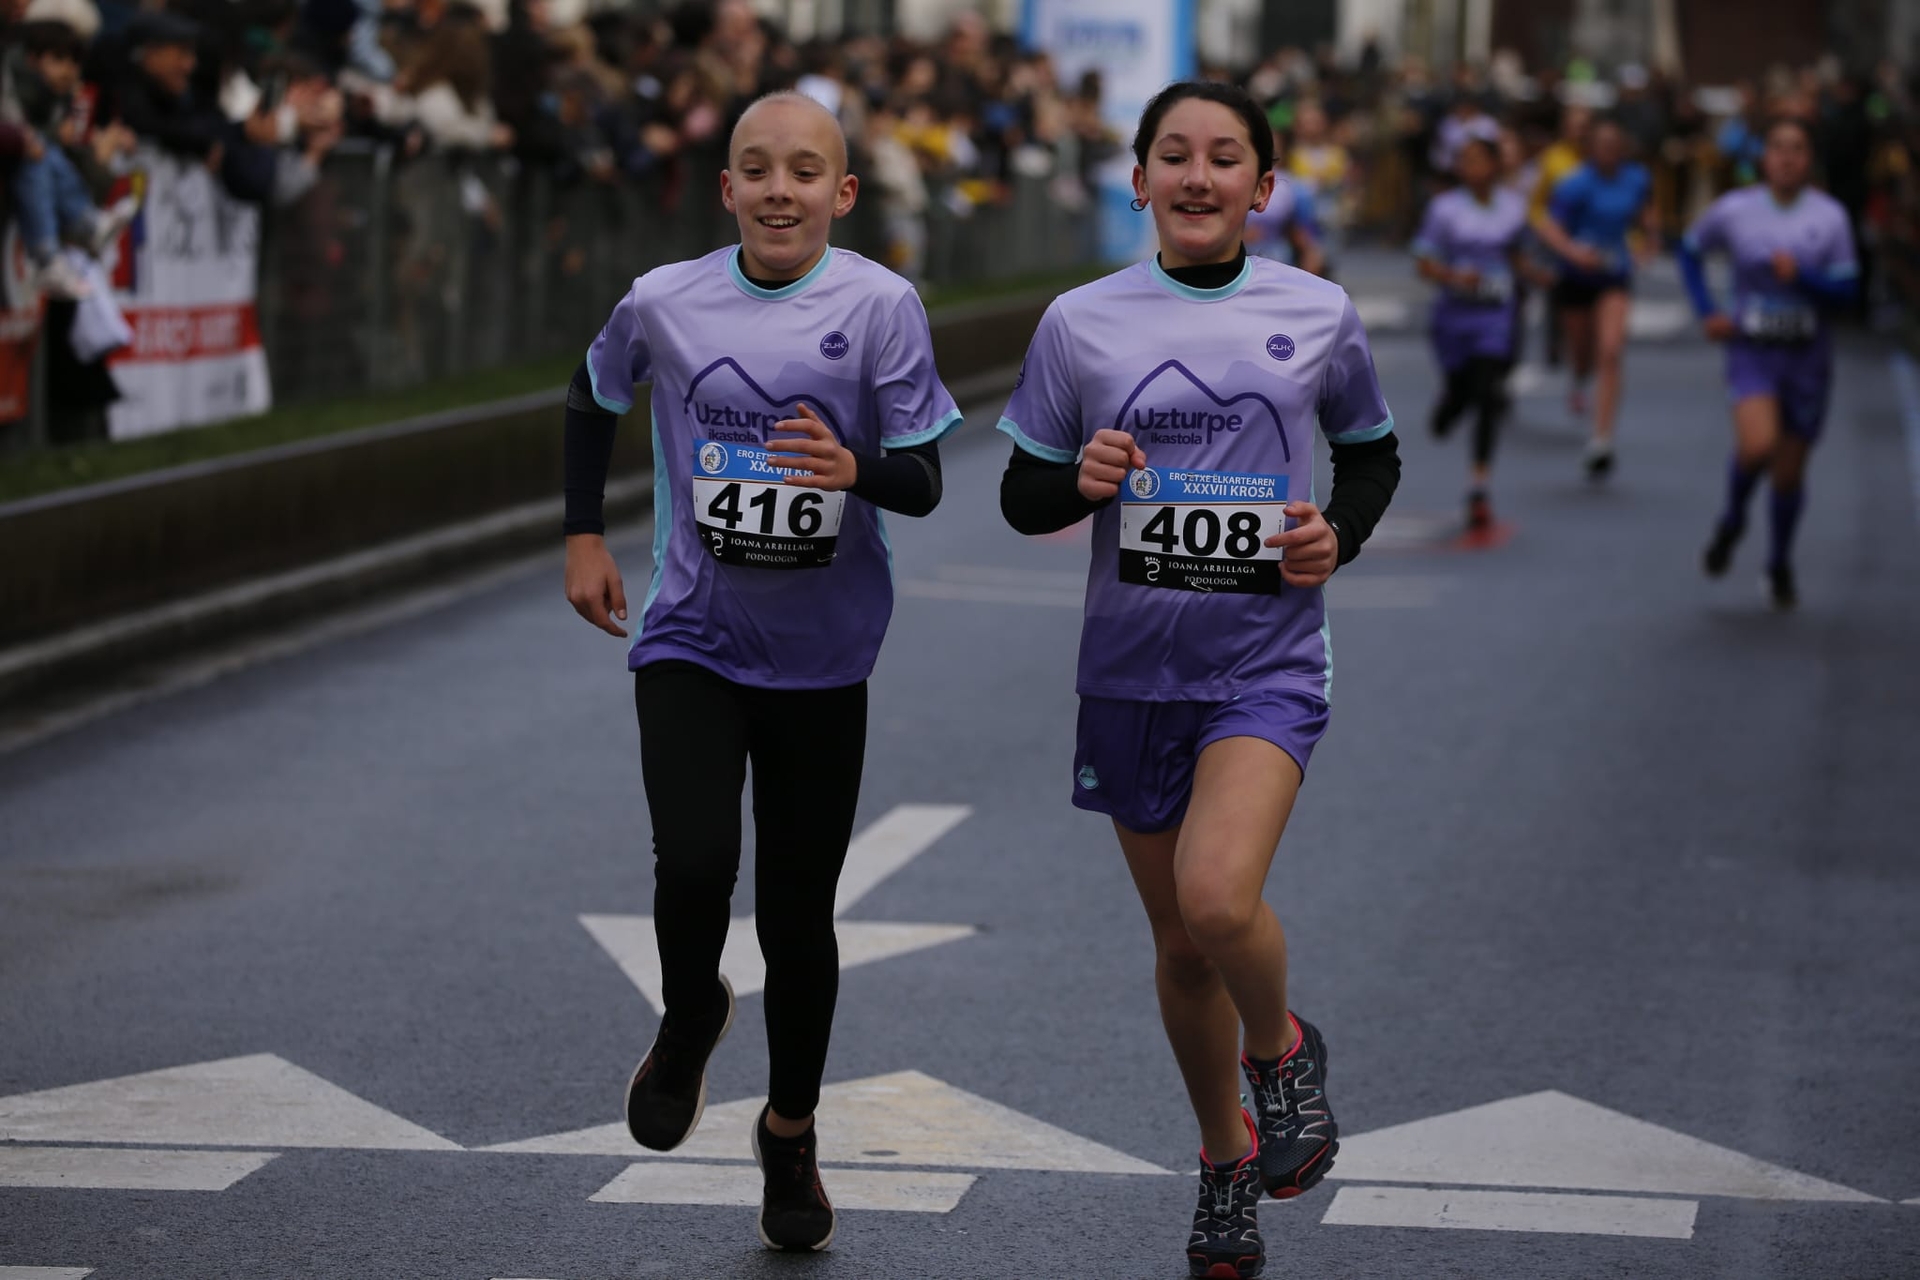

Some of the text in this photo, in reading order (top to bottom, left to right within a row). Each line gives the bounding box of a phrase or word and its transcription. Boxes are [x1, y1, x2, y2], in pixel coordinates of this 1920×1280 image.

[1134, 408, 1243, 445] Uzturpe
[708, 429, 759, 443] ikastola
[1150, 432, 1203, 445] ikastola
[736, 449, 755, 459] ERO
[1169, 472, 1276, 487] ERO ETXE ELKARTEAREN
[1183, 482, 1275, 499] XXXVII KROSA
[708, 483, 824, 537] 416
[1140, 506, 1262, 559] 408
[730, 537, 815, 551] IOANA ARBILLAGA
[745, 552, 798, 562] PODOLOGOA
[1168, 561, 1256, 574] IOANA ARBILLAGA
[1184, 575, 1238, 586] PODOLOGOA
